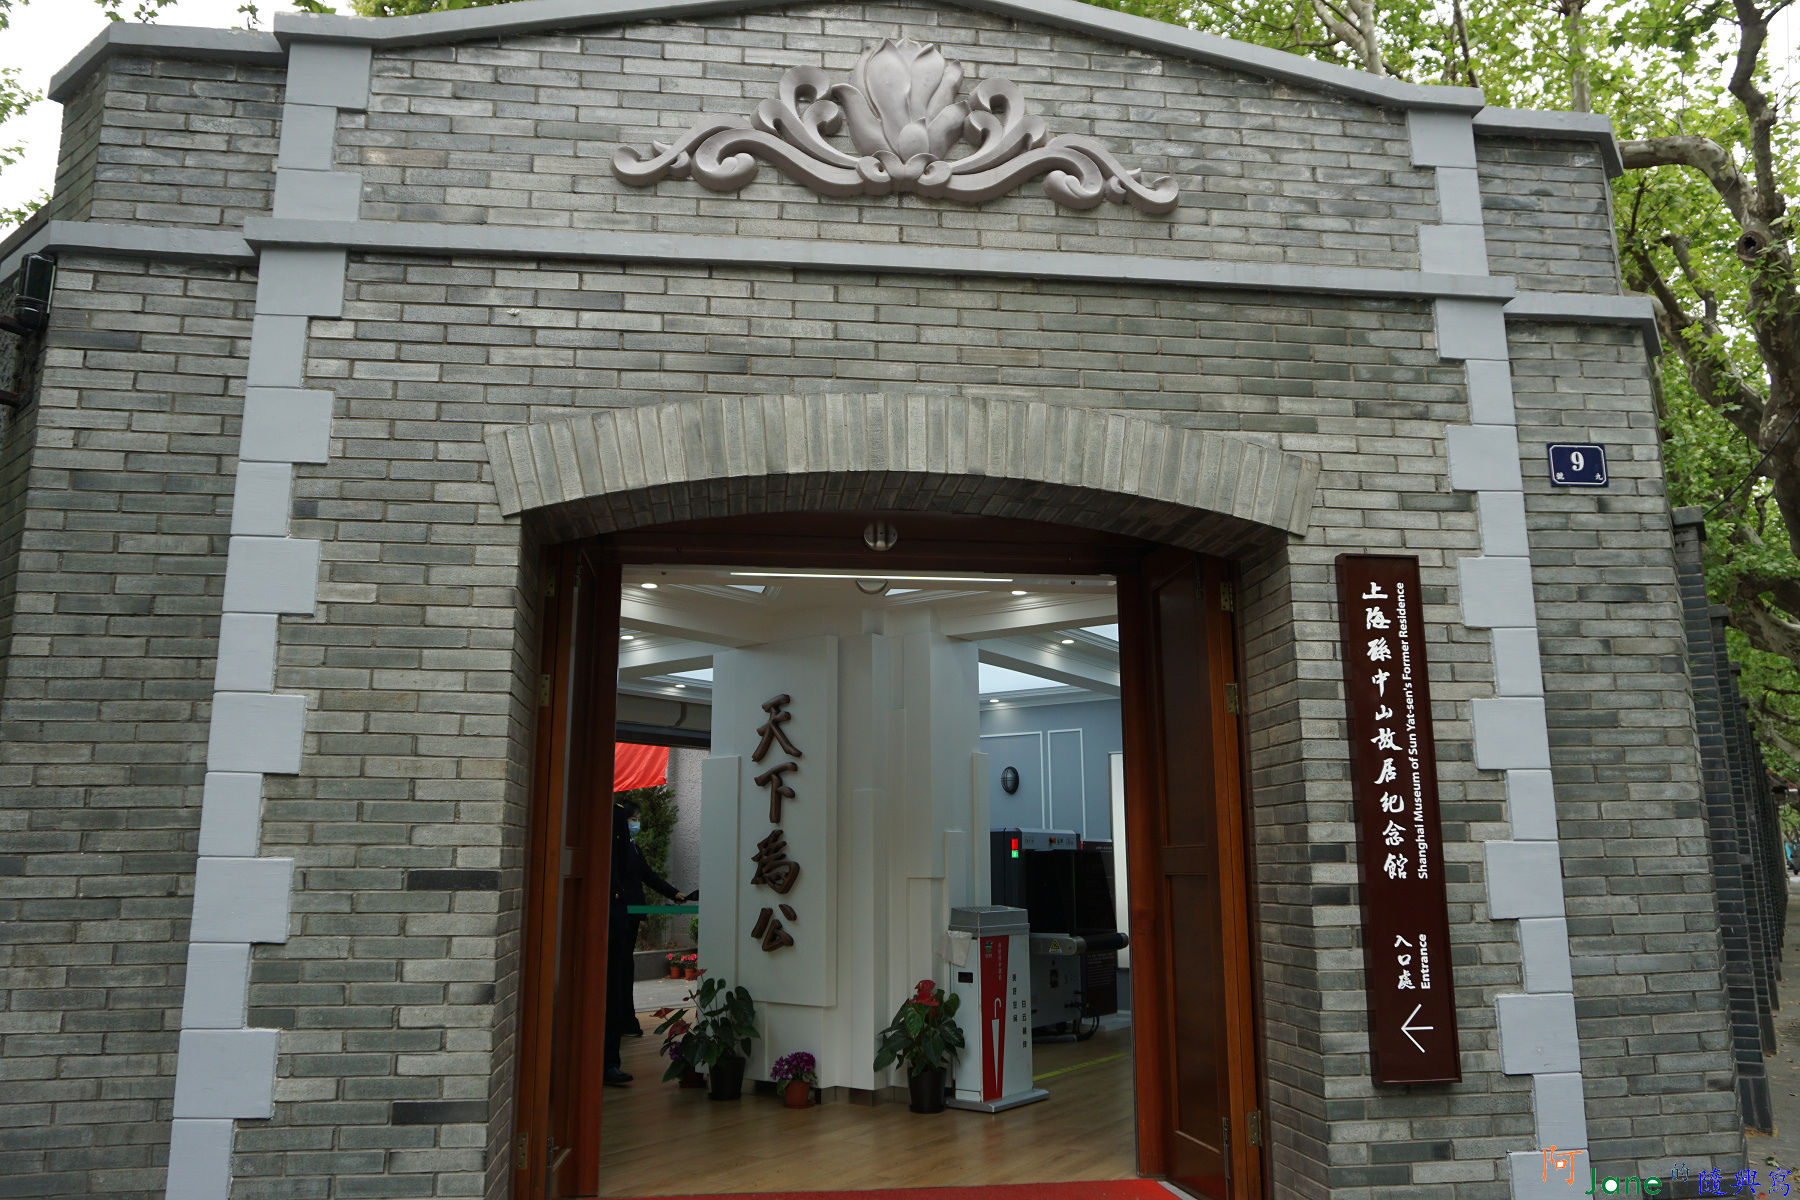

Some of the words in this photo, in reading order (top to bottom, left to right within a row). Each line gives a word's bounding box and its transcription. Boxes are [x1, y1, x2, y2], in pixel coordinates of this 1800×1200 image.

[1570, 451, 1584, 471] 9
[1396, 582, 1408, 638] Residence
[1401, 639, 1411, 681] Former
[1403, 682, 1416, 732] Yat-sen's
[1408, 733, 1418, 756] Sun
[1409, 757, 1420, 770] of
[1412, 772, 1424, 822] Museum
[1414, 824, 1429, 880] Shanghai
[1418, 933, 1431, 990] Entrance
